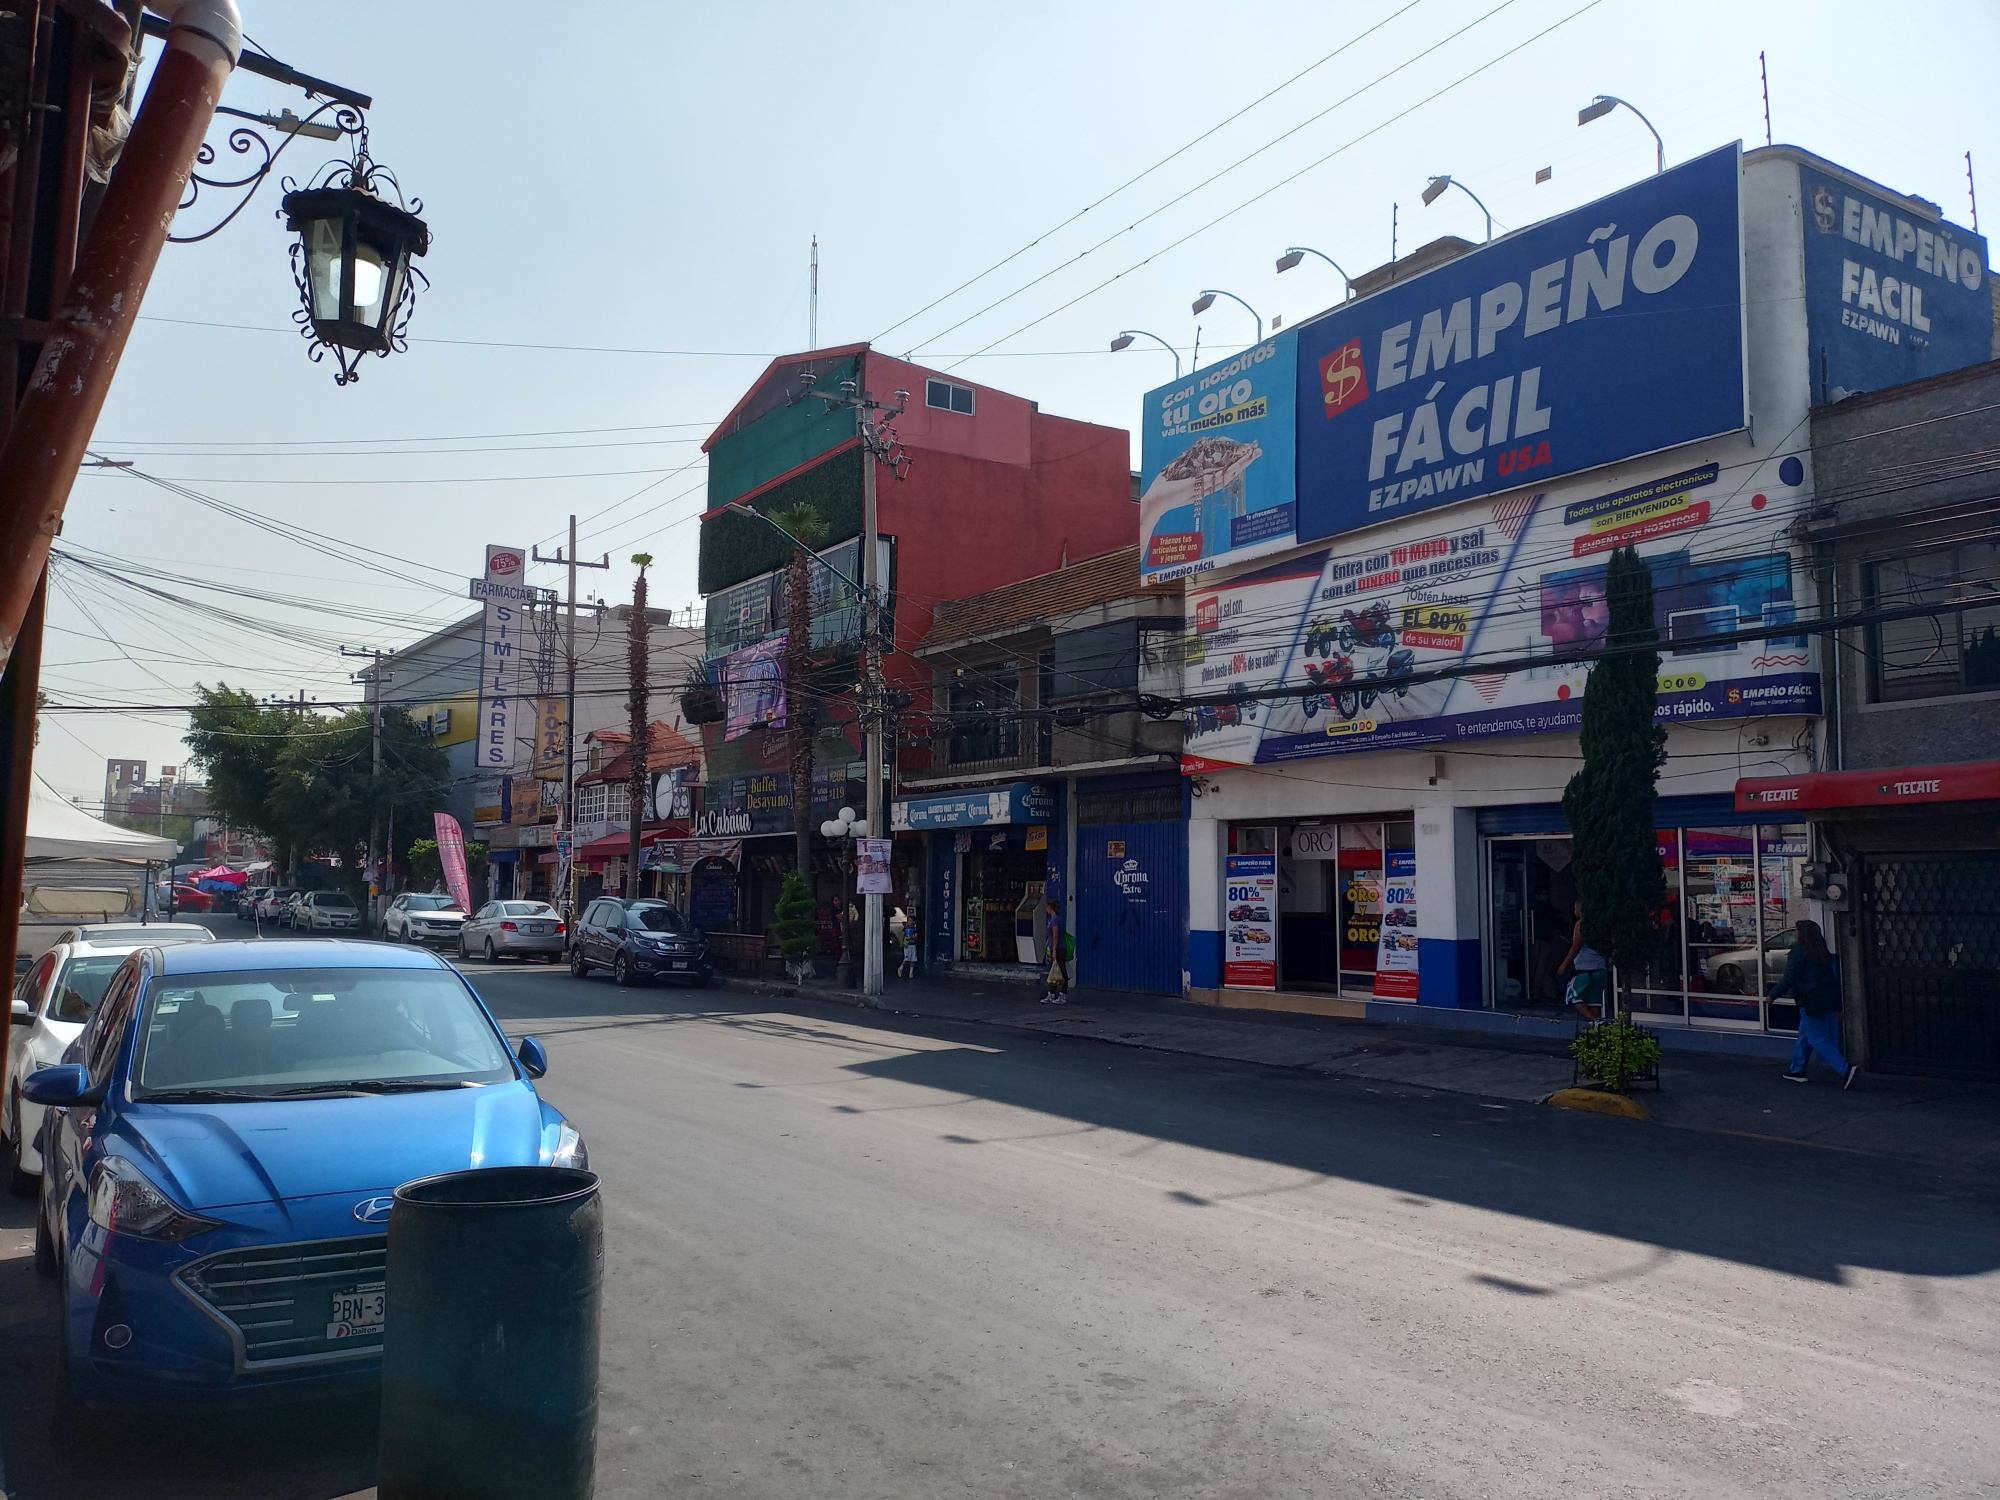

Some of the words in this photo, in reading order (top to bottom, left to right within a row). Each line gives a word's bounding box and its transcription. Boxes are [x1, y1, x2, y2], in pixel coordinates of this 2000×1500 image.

[1842, 196, 1982, 291] EMPEÑO
[1375, 214, 1699, 392] EMPEÑO
[1841, 308, 1900, 346] EZPAWN
[1199, 341, 1276, 391] nosotros
[1161, 403, 1190, 427] tu
[1198, 379, 1252, 415] oro
[1161, 425, 1188, 438] vale
[1190, 411, 1234, 431] mucho
[1367, 366, 1552, 482] FÁCIL
[1367, 458, 1485, 513] EZPAWN
[1497, 440, 1552, 477] USA
[1569, 506, 1595, 519] Todos
[1595, 500, 1611, 511] tus
[1612, 487, 1655, 507] aparatos
[1655, 472, 1715, 494] electrónicos
[1595, 517, 1613, 528] son
[1616, 495, 1684, 522] BIENVENIDOS
[1621, 529, 1642, 540] CON
[1643, 511, 1700, 537] NOSOTROS!
[1182, 535, 1193, 543] tus
[1152, 545, 1179, 555] artículos
[1179, 544, 1187, 552] de
[1333, 562, 1362, 580] Entra
[1365, 554, 1389, 572] con
[1389, 549, 1408, 567] TU
[1410, 538, 1448, 562] MOTO
[1449, 537, 1459, 553] y
[1461, 529, 1485, 549] sal
[494, 556, 516, 569] 75%
[1160, 555, 1165, 564] y
[1159, 566, 1194, 582] EMPEÑO
[1193, 559, 1216, 576] FÁCIL
[1322, 587, 1342, 600] con
[1344, 582, 1356, 596] el
[1357, 570, 1400, 592] DINERO
[1402, 565, 1427, 583] que
[1430, 549, 1499, 575] necesitas
[1406, 590, 1439, 603] ¡Obtén
[1441, 592, 1469, 605] hasta
[1223, 599, 1231, 618] sal
[1232, 599, 1243, 615] con
[1403, 610, 1423, 628] EL
[1429, 612, 1467, 632] 80%
[1405, 633, 1416, 644] de
[1418, 636, 1429, 645] su
[1232, 653, 1247, 675] 80%
[1248, 656, 1255, 671] de
[1255, 656, 1262, 670] su
[488, 606, 512, 762] SIMILARES
[1742, 685, 1786, 699] EMPEÑO
[1788, 683, 1813, 697] FÁCIL
[1673, 699, 1715, 716] rápido.
[543, 701, 560, 761] FOTO
[1456, 723, 1466, 735] Te
[1467, 718, 1525, 735] entendemos,
[1526, 716, 1536, 728] te
[1537, 712, 1583, 730] ayudamo
[1392, 731, 1402, 739] Fácil
[750, 775, 777, 794] Buffet
[829, 786, 845, 799] $119
[1894, 780, 1942, 795] TECATE
[747, 794, 789, 813] Desayuno
[1021, 794, 1054, 808] Corona
[1759, 788, 1800, 802] TECATE
[909, 809, 928, 823] Corona
[968, 803, 988, 818] Corona
[1030, 806, 1050, 818] Extra
[695, 809, 708, 838] La
[1767, 843, 1807, 853] REMAT
[1113, 869, 1149, 888] Corona
[1122, 884, 1142, 895] Extra
[1229, 887, 1260, 901] 80%
[1346, 887, 1379, 902] ORO
[1387, 888, 1414, 904] 80%
[1359, 905, 1368, 916] y
[1347, 927, 1379, 943] ORO
[333, 1296, 385, 1320] PBN-3
[351, 1327, 377, 1336] Dalton
